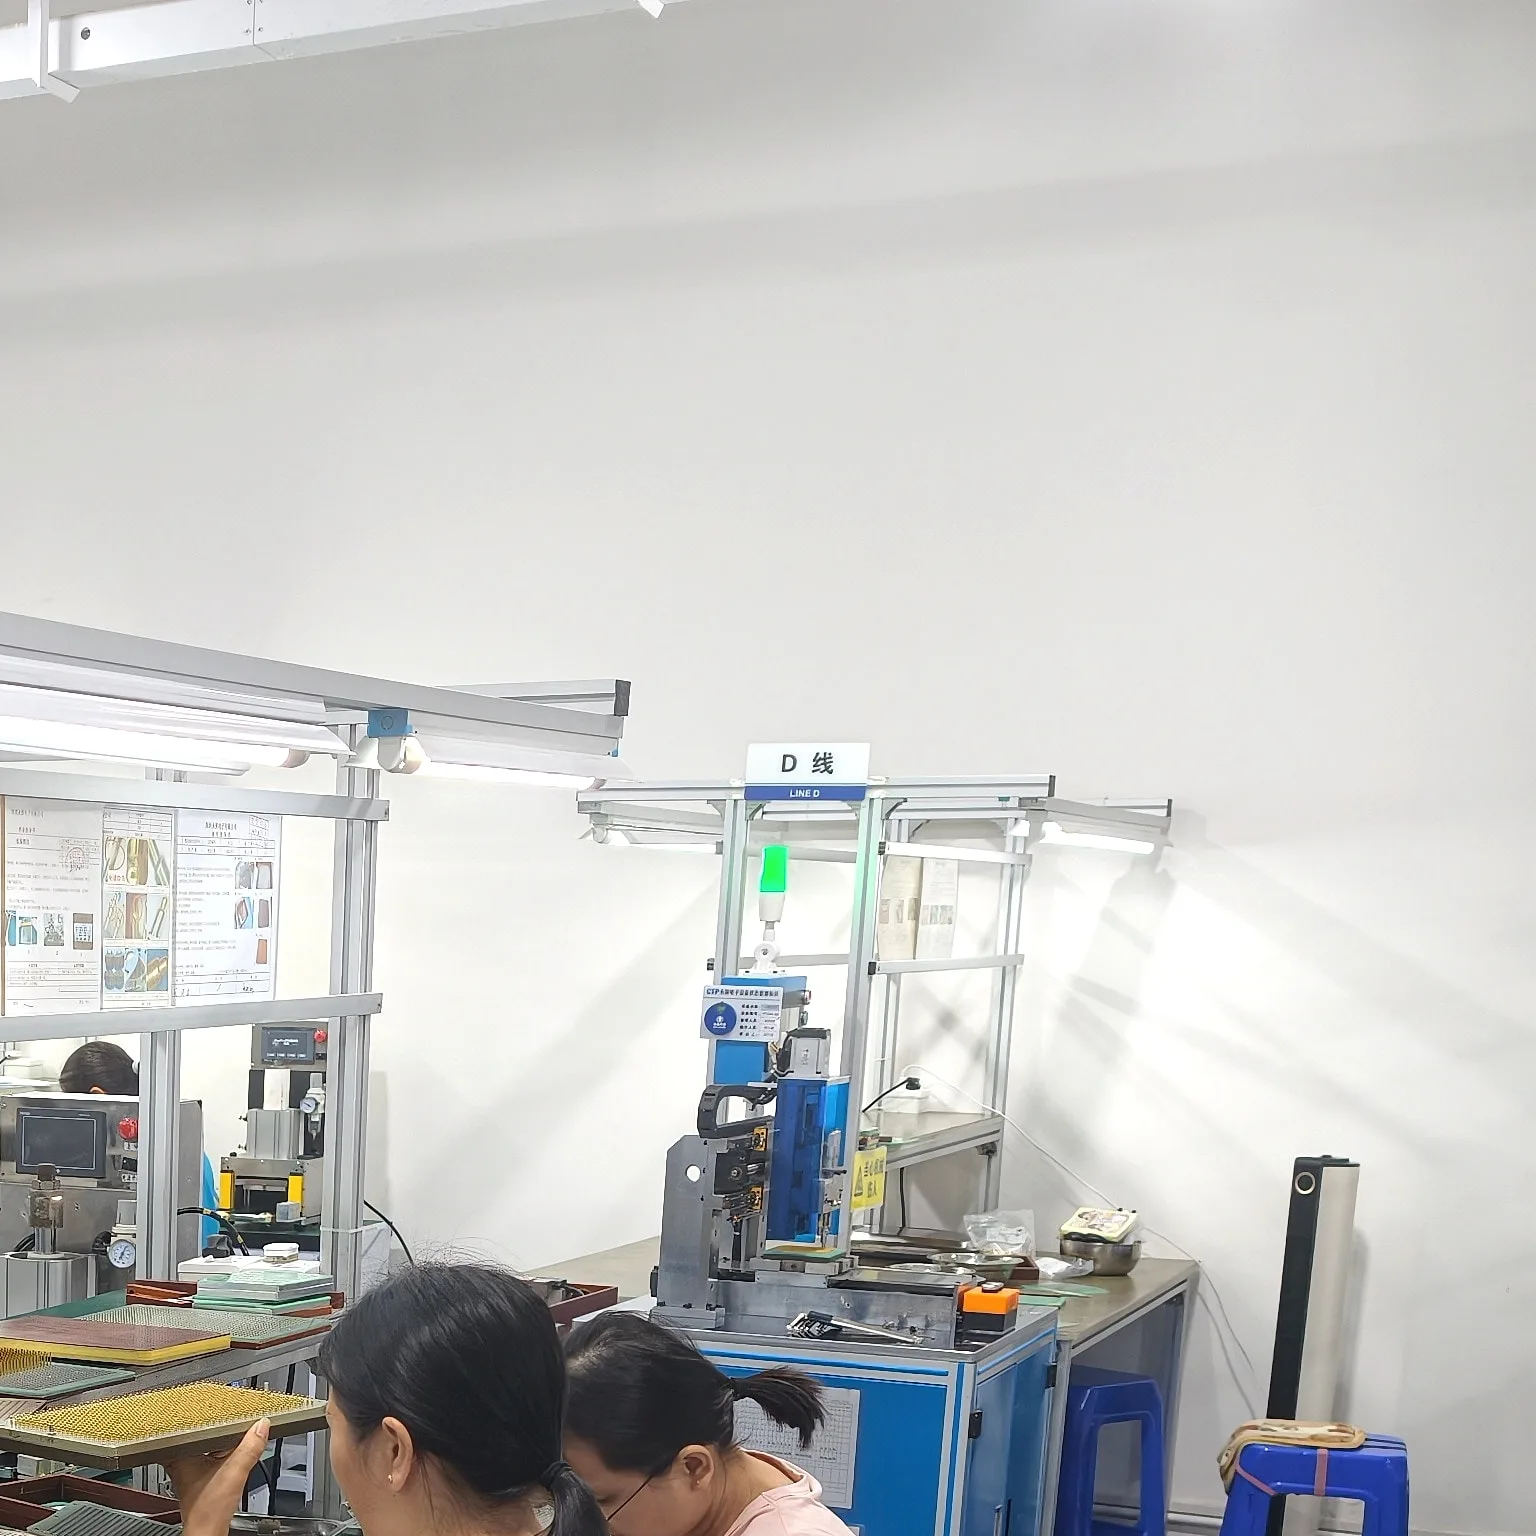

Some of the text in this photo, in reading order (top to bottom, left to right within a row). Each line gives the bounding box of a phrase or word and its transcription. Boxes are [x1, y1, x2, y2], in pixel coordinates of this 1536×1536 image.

[781, 752, 834, 774] D 线
[789, 789, 820, 798] LINE D
